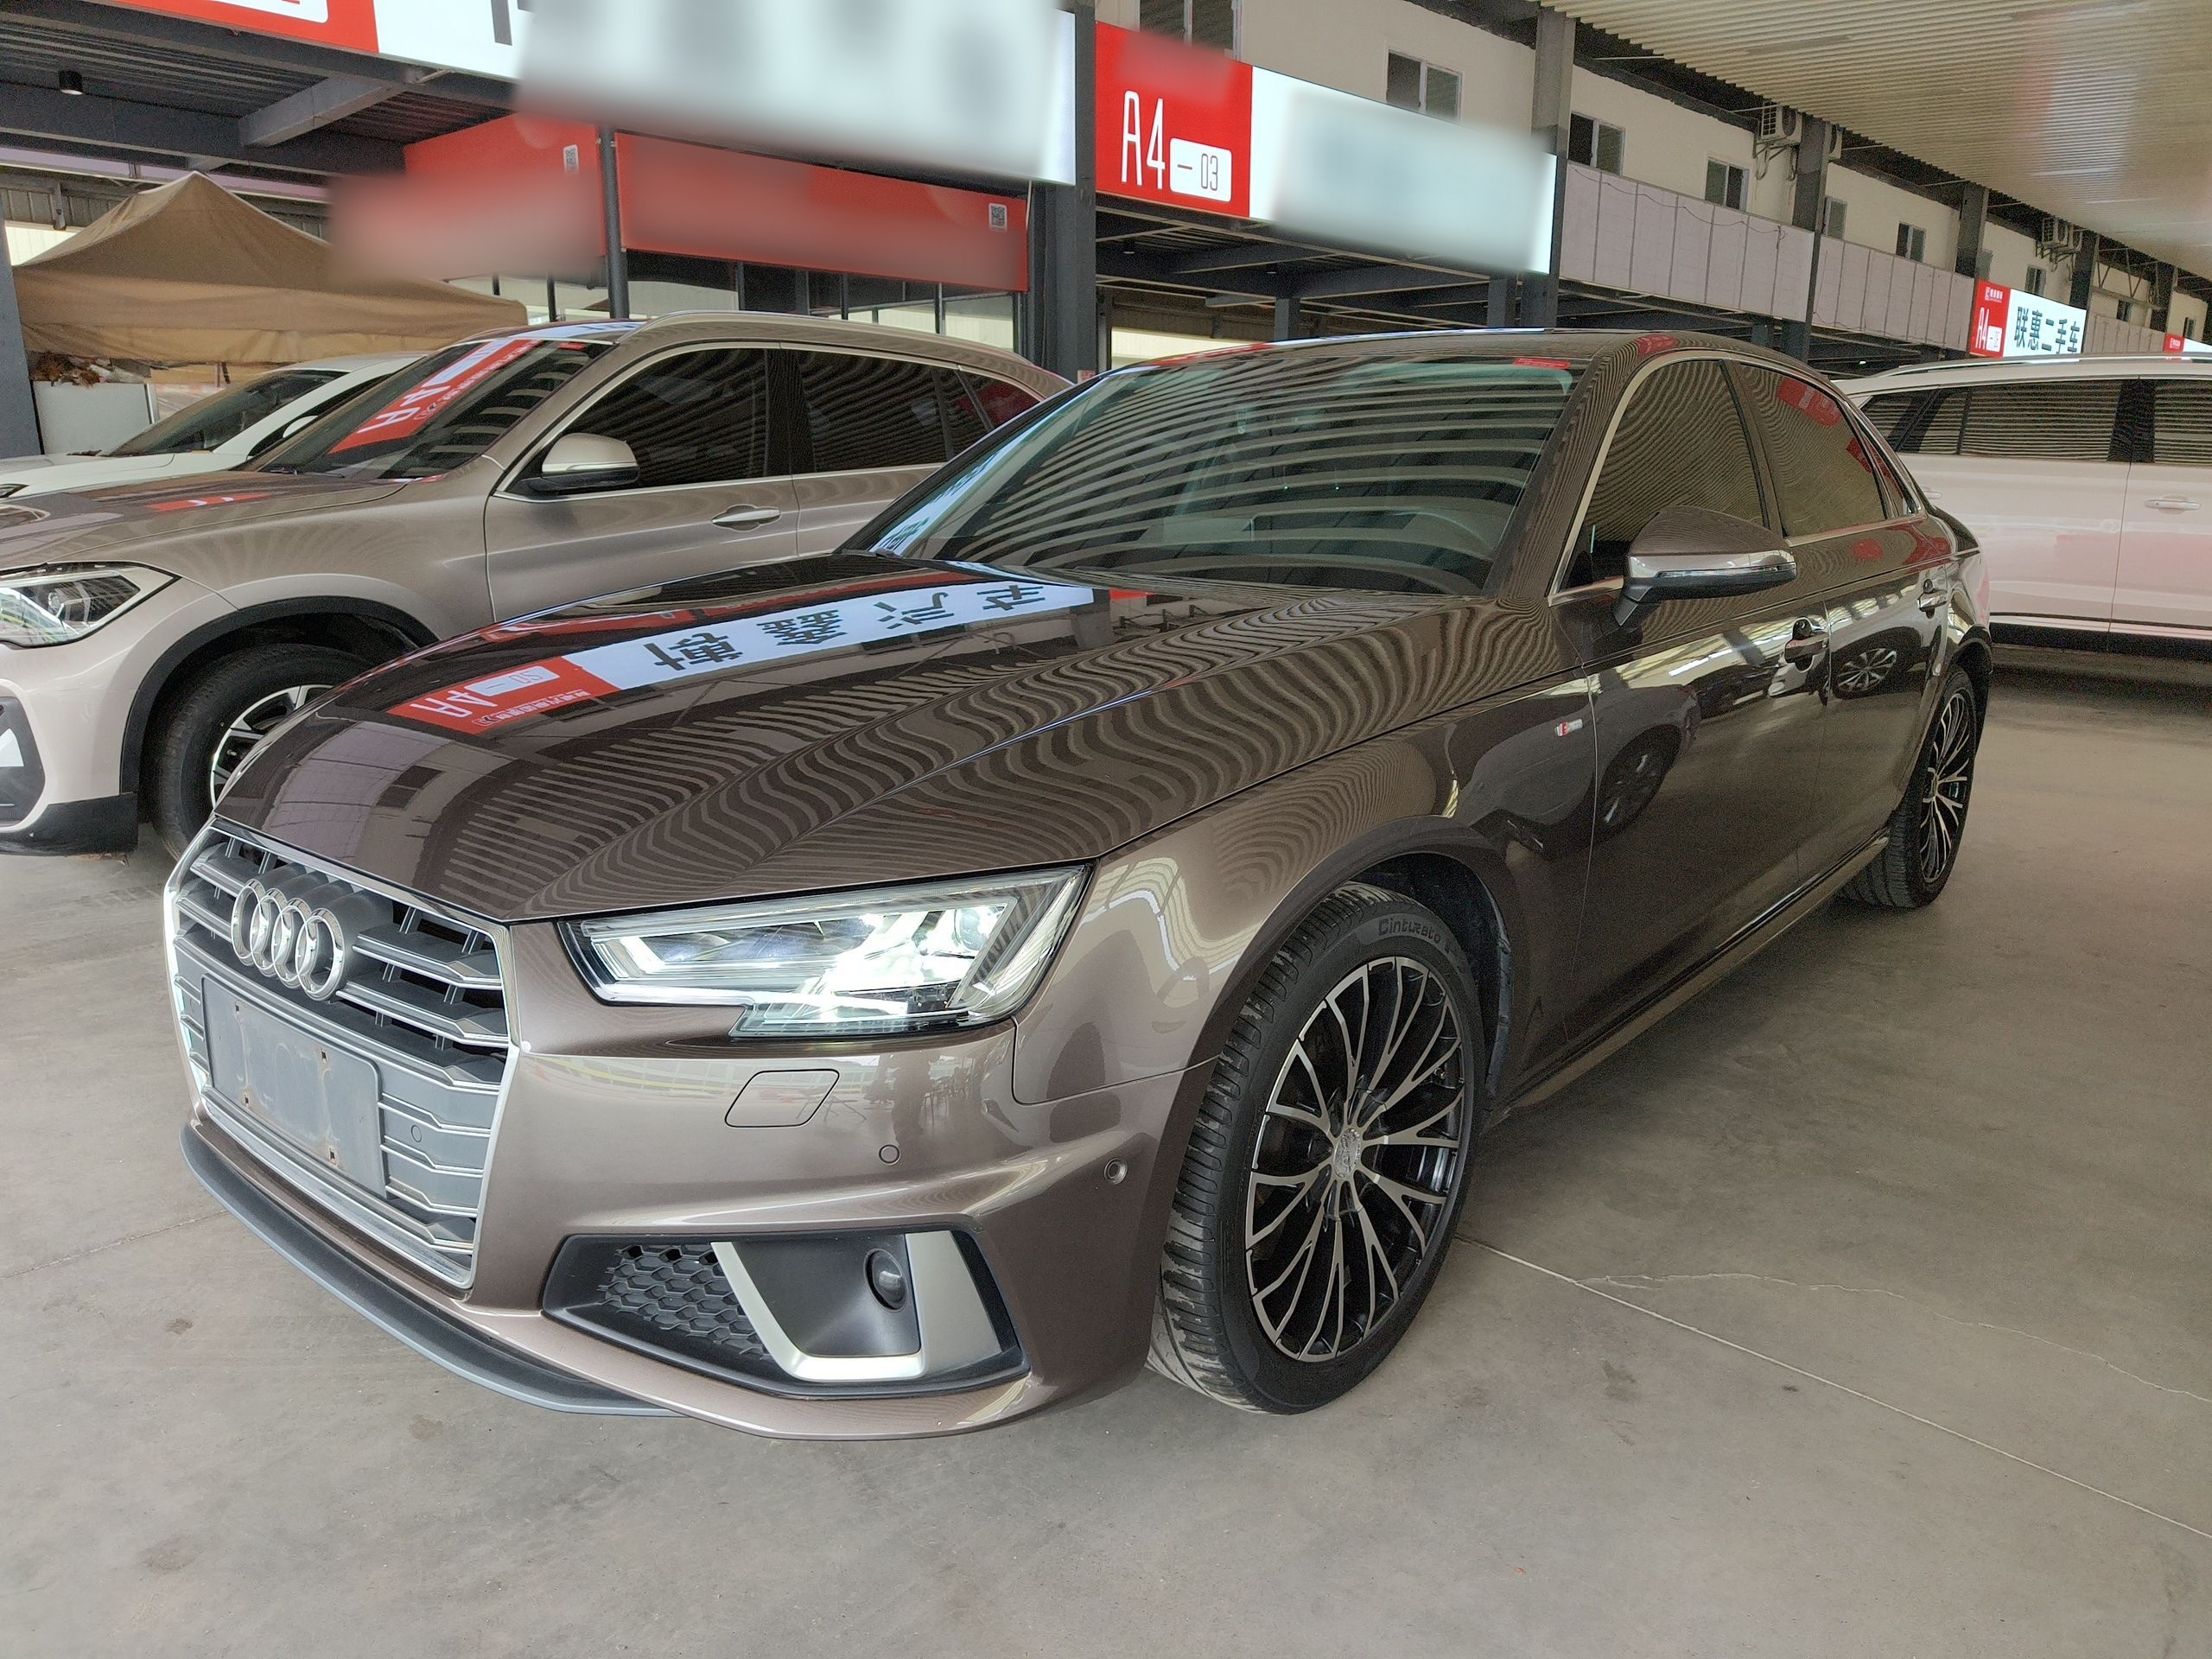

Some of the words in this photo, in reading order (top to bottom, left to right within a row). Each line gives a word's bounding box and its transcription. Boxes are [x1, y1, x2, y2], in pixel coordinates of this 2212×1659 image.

[2014, 306, 2081, 354] 联惠二手车
[1378, 918, 1441, 944] Cinturato
